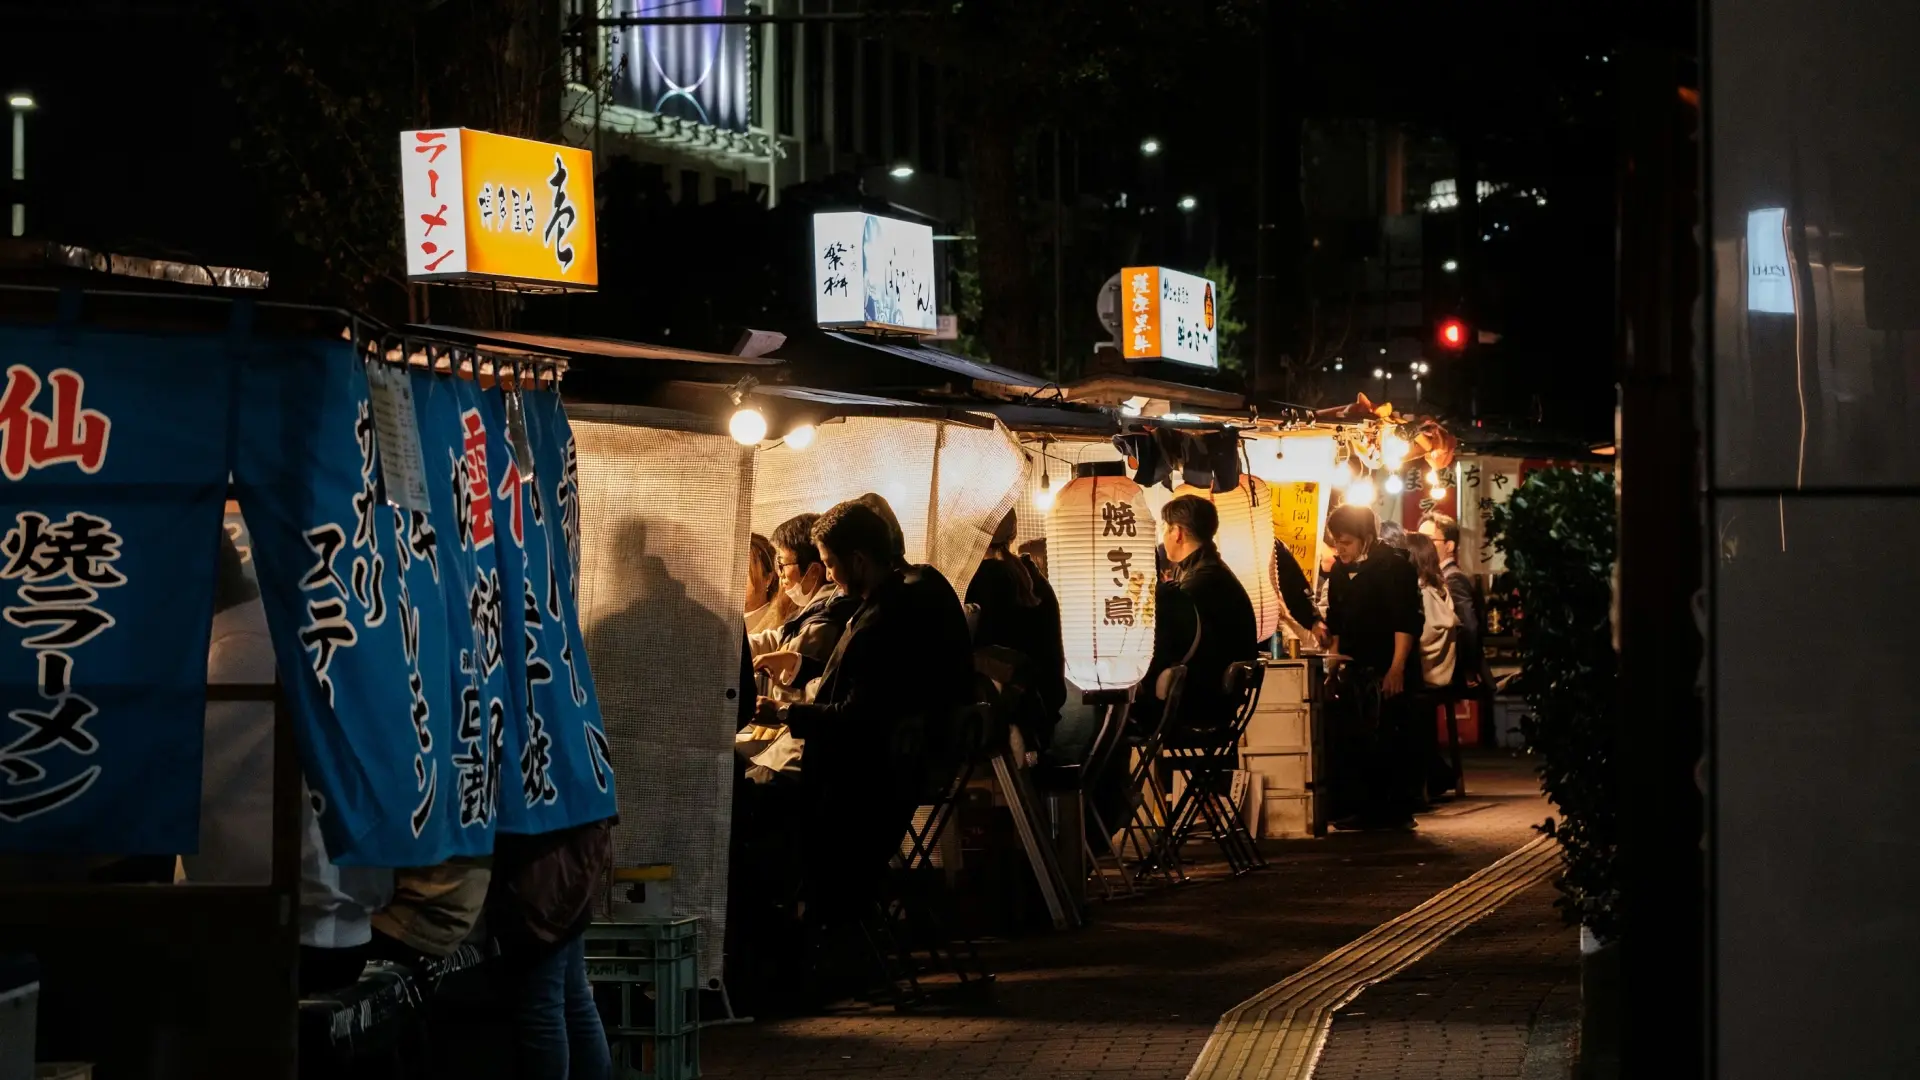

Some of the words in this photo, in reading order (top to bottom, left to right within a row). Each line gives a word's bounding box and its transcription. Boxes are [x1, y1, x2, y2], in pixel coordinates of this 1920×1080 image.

[415, 132, 454, 271] ラーメン
[0, 364, 111, 480] 仙
[1102, 500, 1137, 627] 焼き鳥
[0, 511, 128, 821] 焼ラーメン
